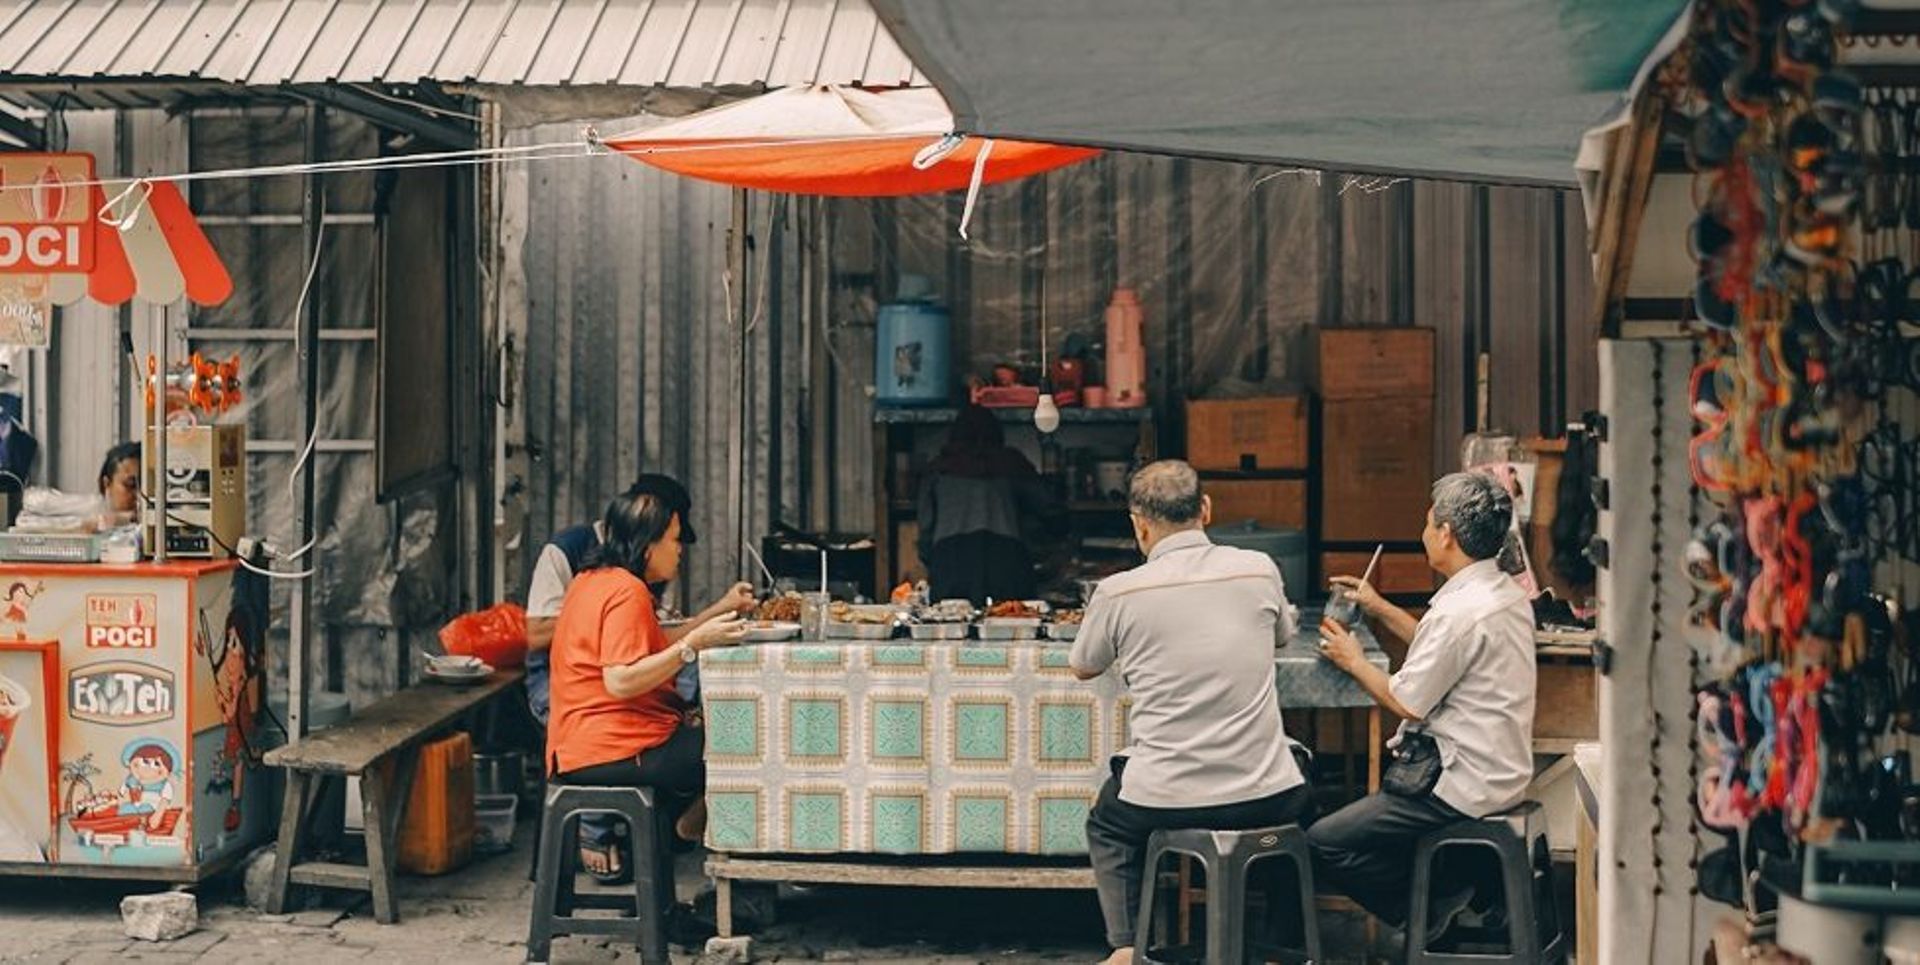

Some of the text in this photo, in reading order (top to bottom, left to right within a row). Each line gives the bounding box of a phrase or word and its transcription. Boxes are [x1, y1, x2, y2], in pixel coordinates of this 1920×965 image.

[90, 599, 117, 612] TEH
[90, 626, 152, 647] POCI
[114, 672, 170, 714] Teh
